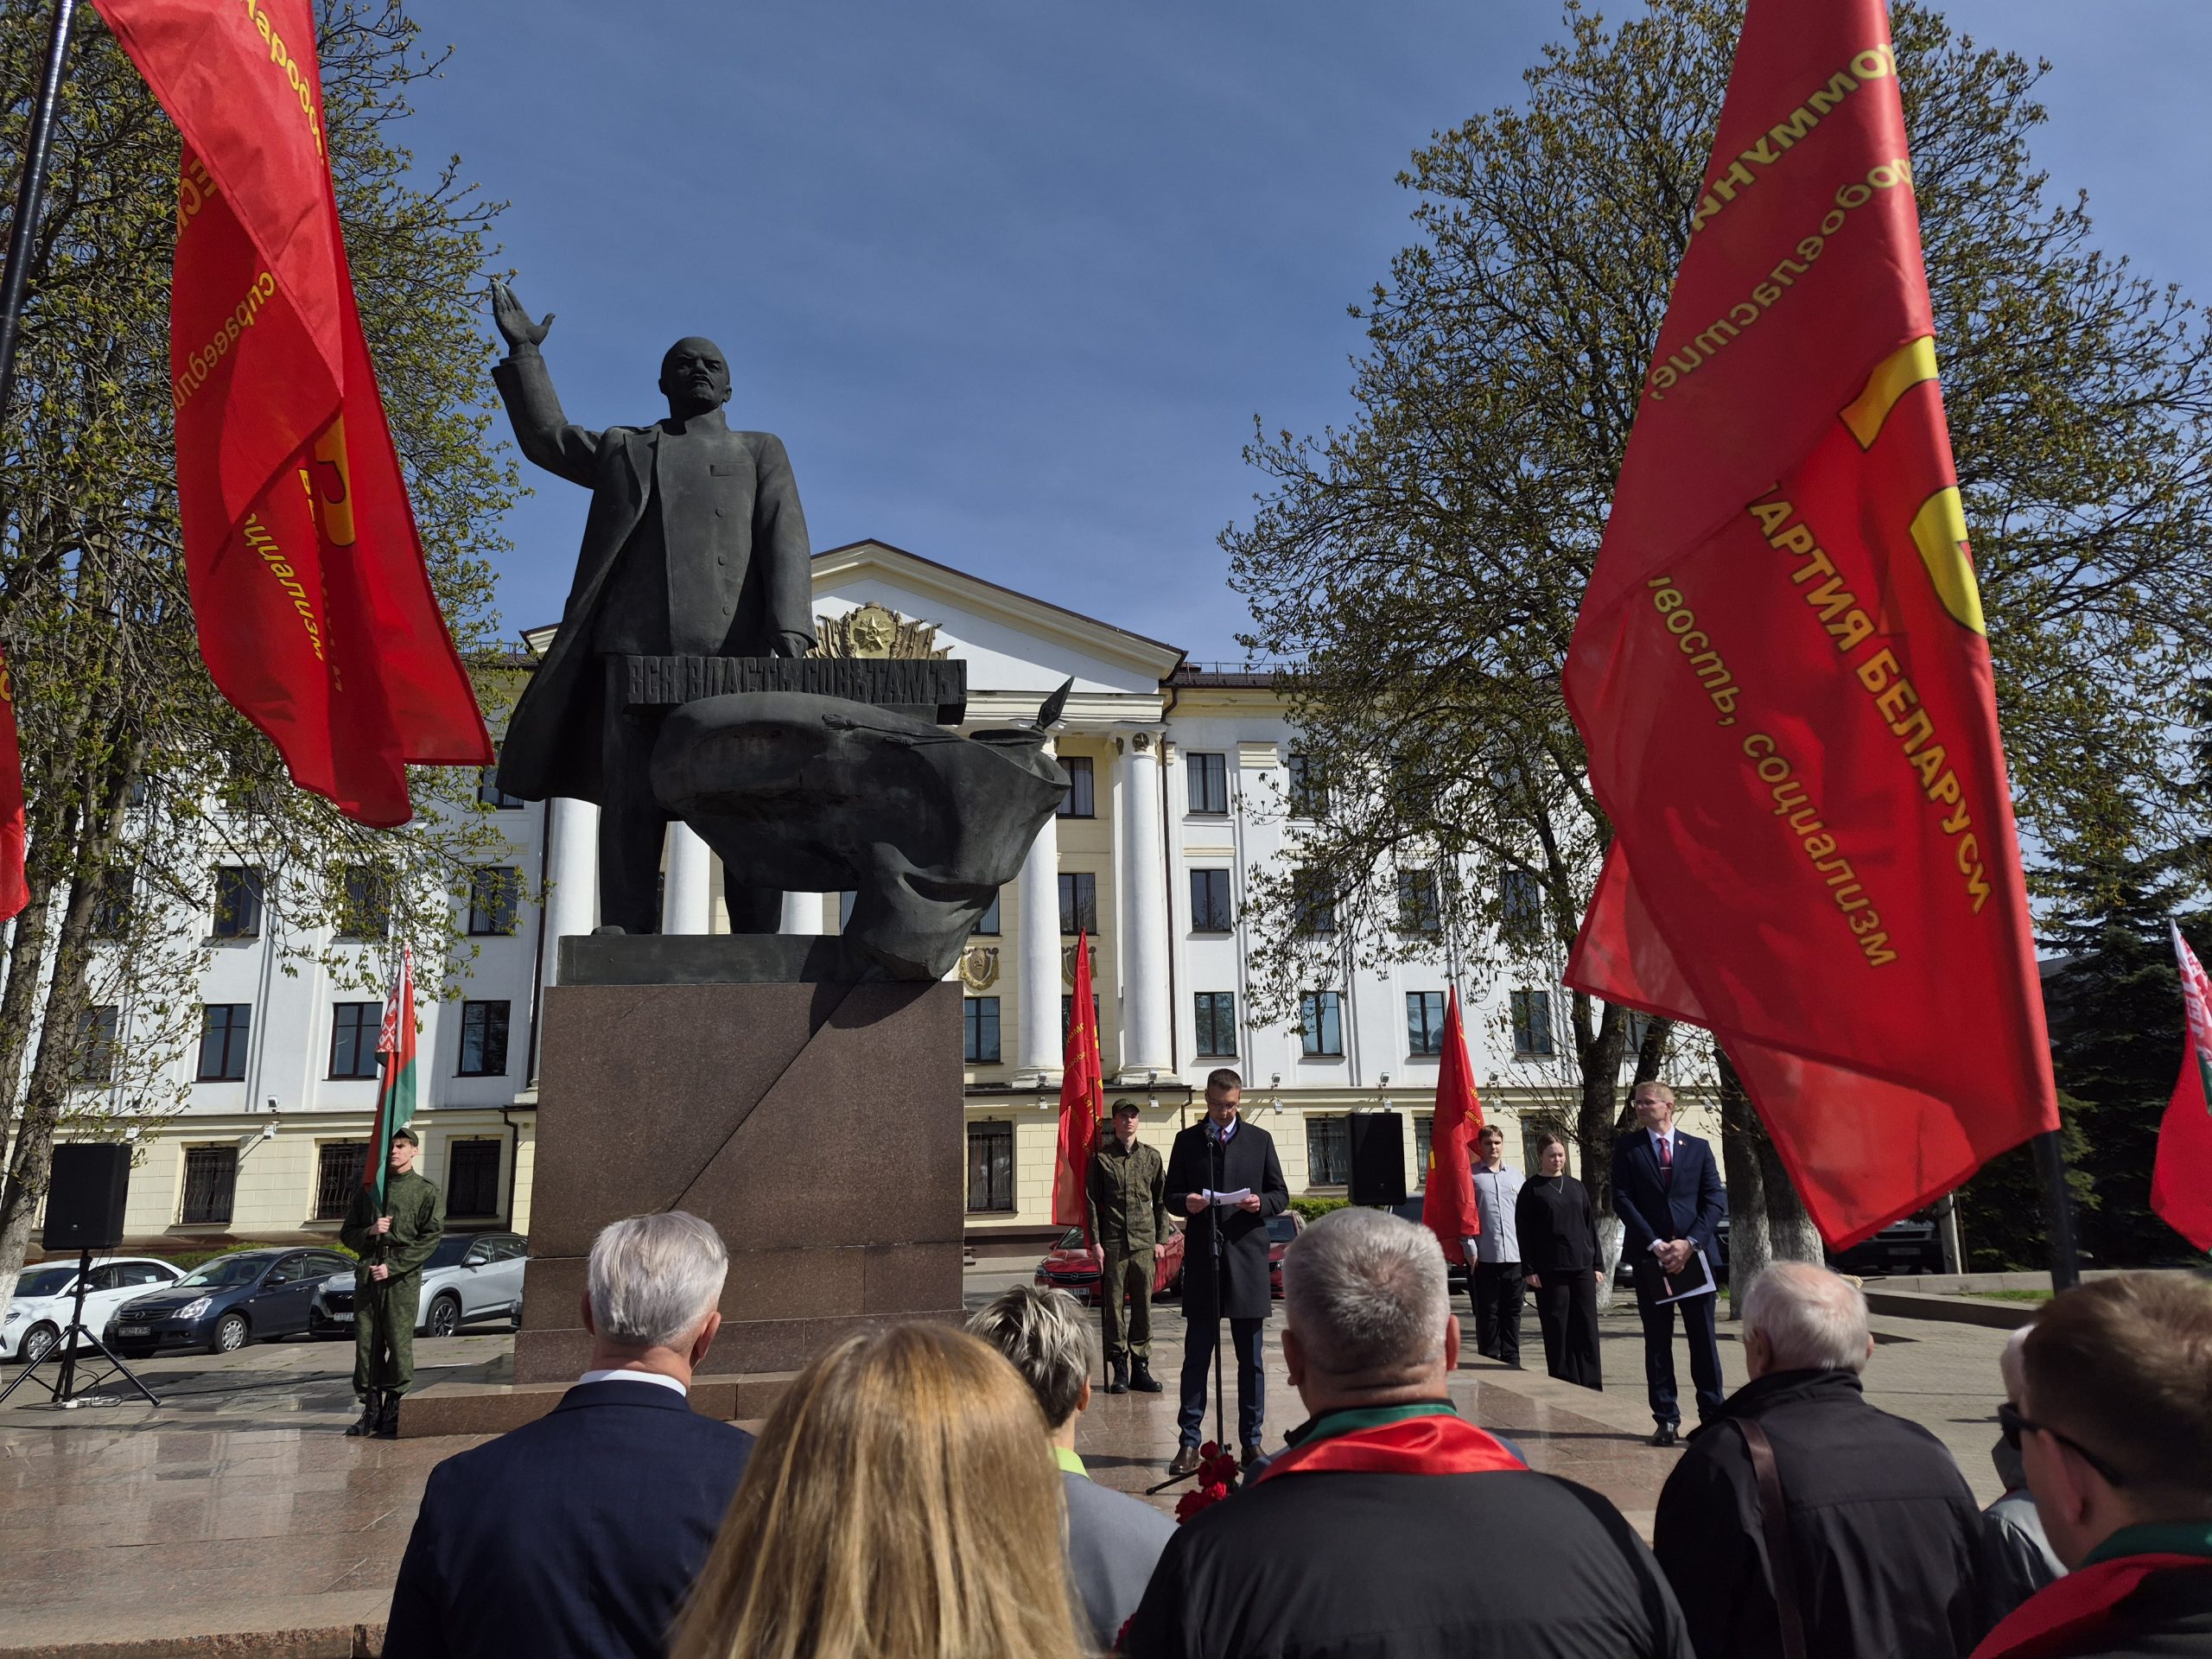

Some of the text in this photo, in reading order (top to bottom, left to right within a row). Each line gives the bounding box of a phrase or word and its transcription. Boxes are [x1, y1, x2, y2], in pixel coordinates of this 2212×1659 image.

[627, 656, 678, 704] ВСЯ
[685, 657, 793, 702] ВЛАСТЬ
[1747, 480, 1992, 915] АРТИЯ БЕЛАРУСИ
[1742, 733, 1898, 968] социализм
